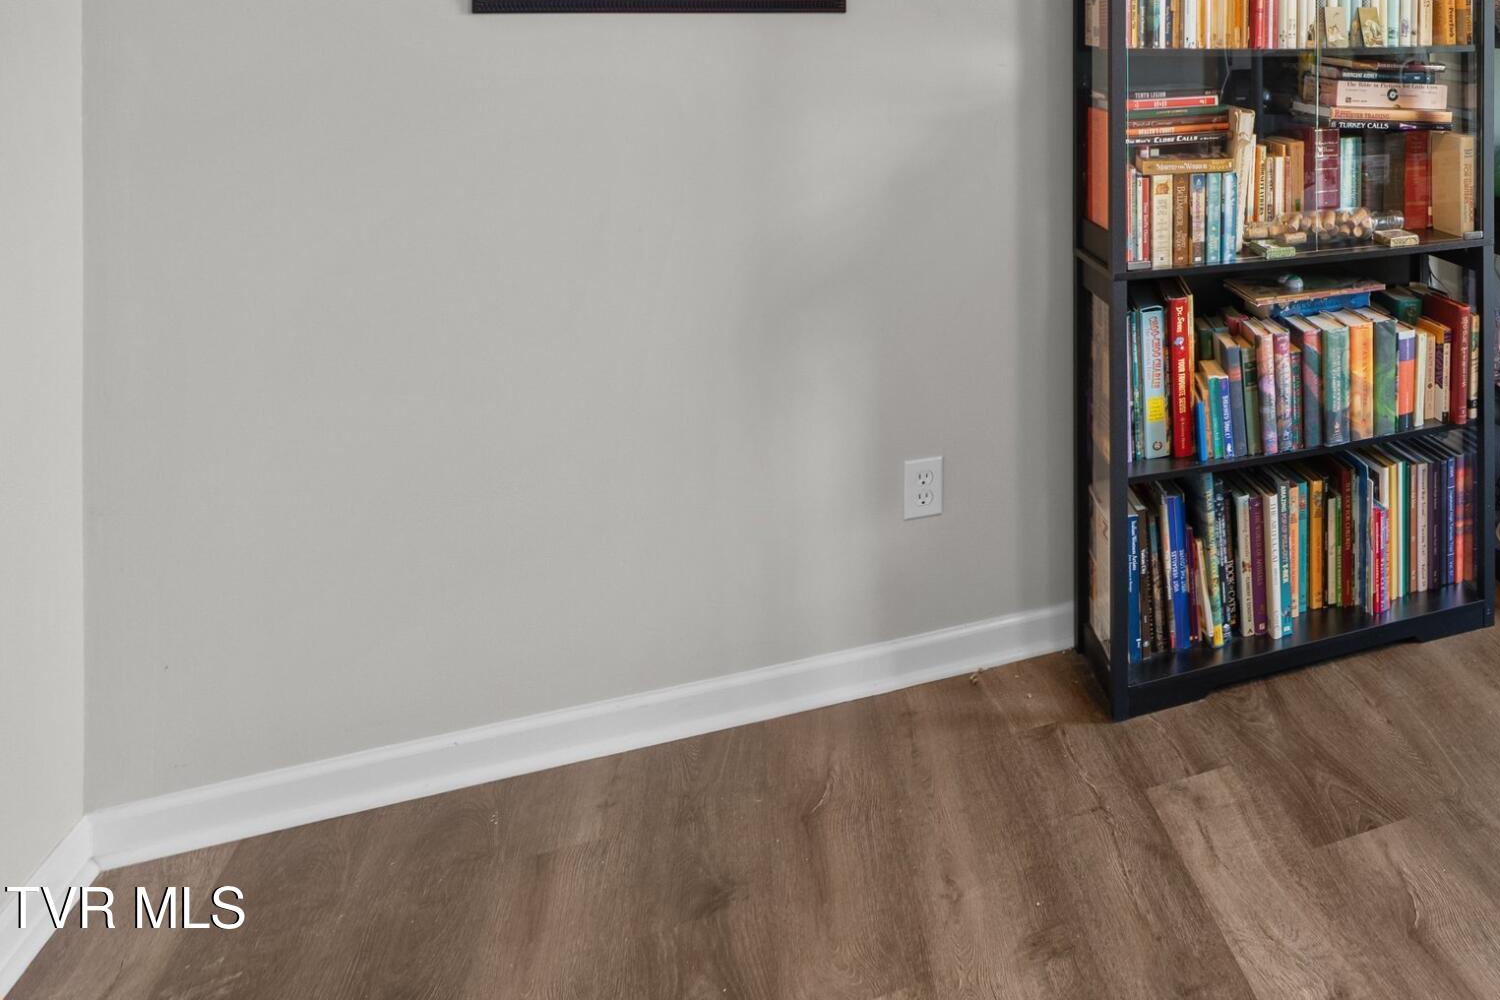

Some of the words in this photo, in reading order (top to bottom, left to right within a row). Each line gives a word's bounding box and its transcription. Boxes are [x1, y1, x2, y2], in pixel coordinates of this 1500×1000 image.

[1339, 121, 1366, 129] TURKEY
[1176, 306, 1184, 316] Dr.
[1176, 316, 1185, 333] Seuss
[1178, 358, 1186, 372] YOUR
[1178, 373, 1186, 397] FAVORITE
[1178, 397, 1186, 414] SEUSS
[1226, 560, 1236, 584] BOOK
[1227, 590, 1236, 613] CATS
